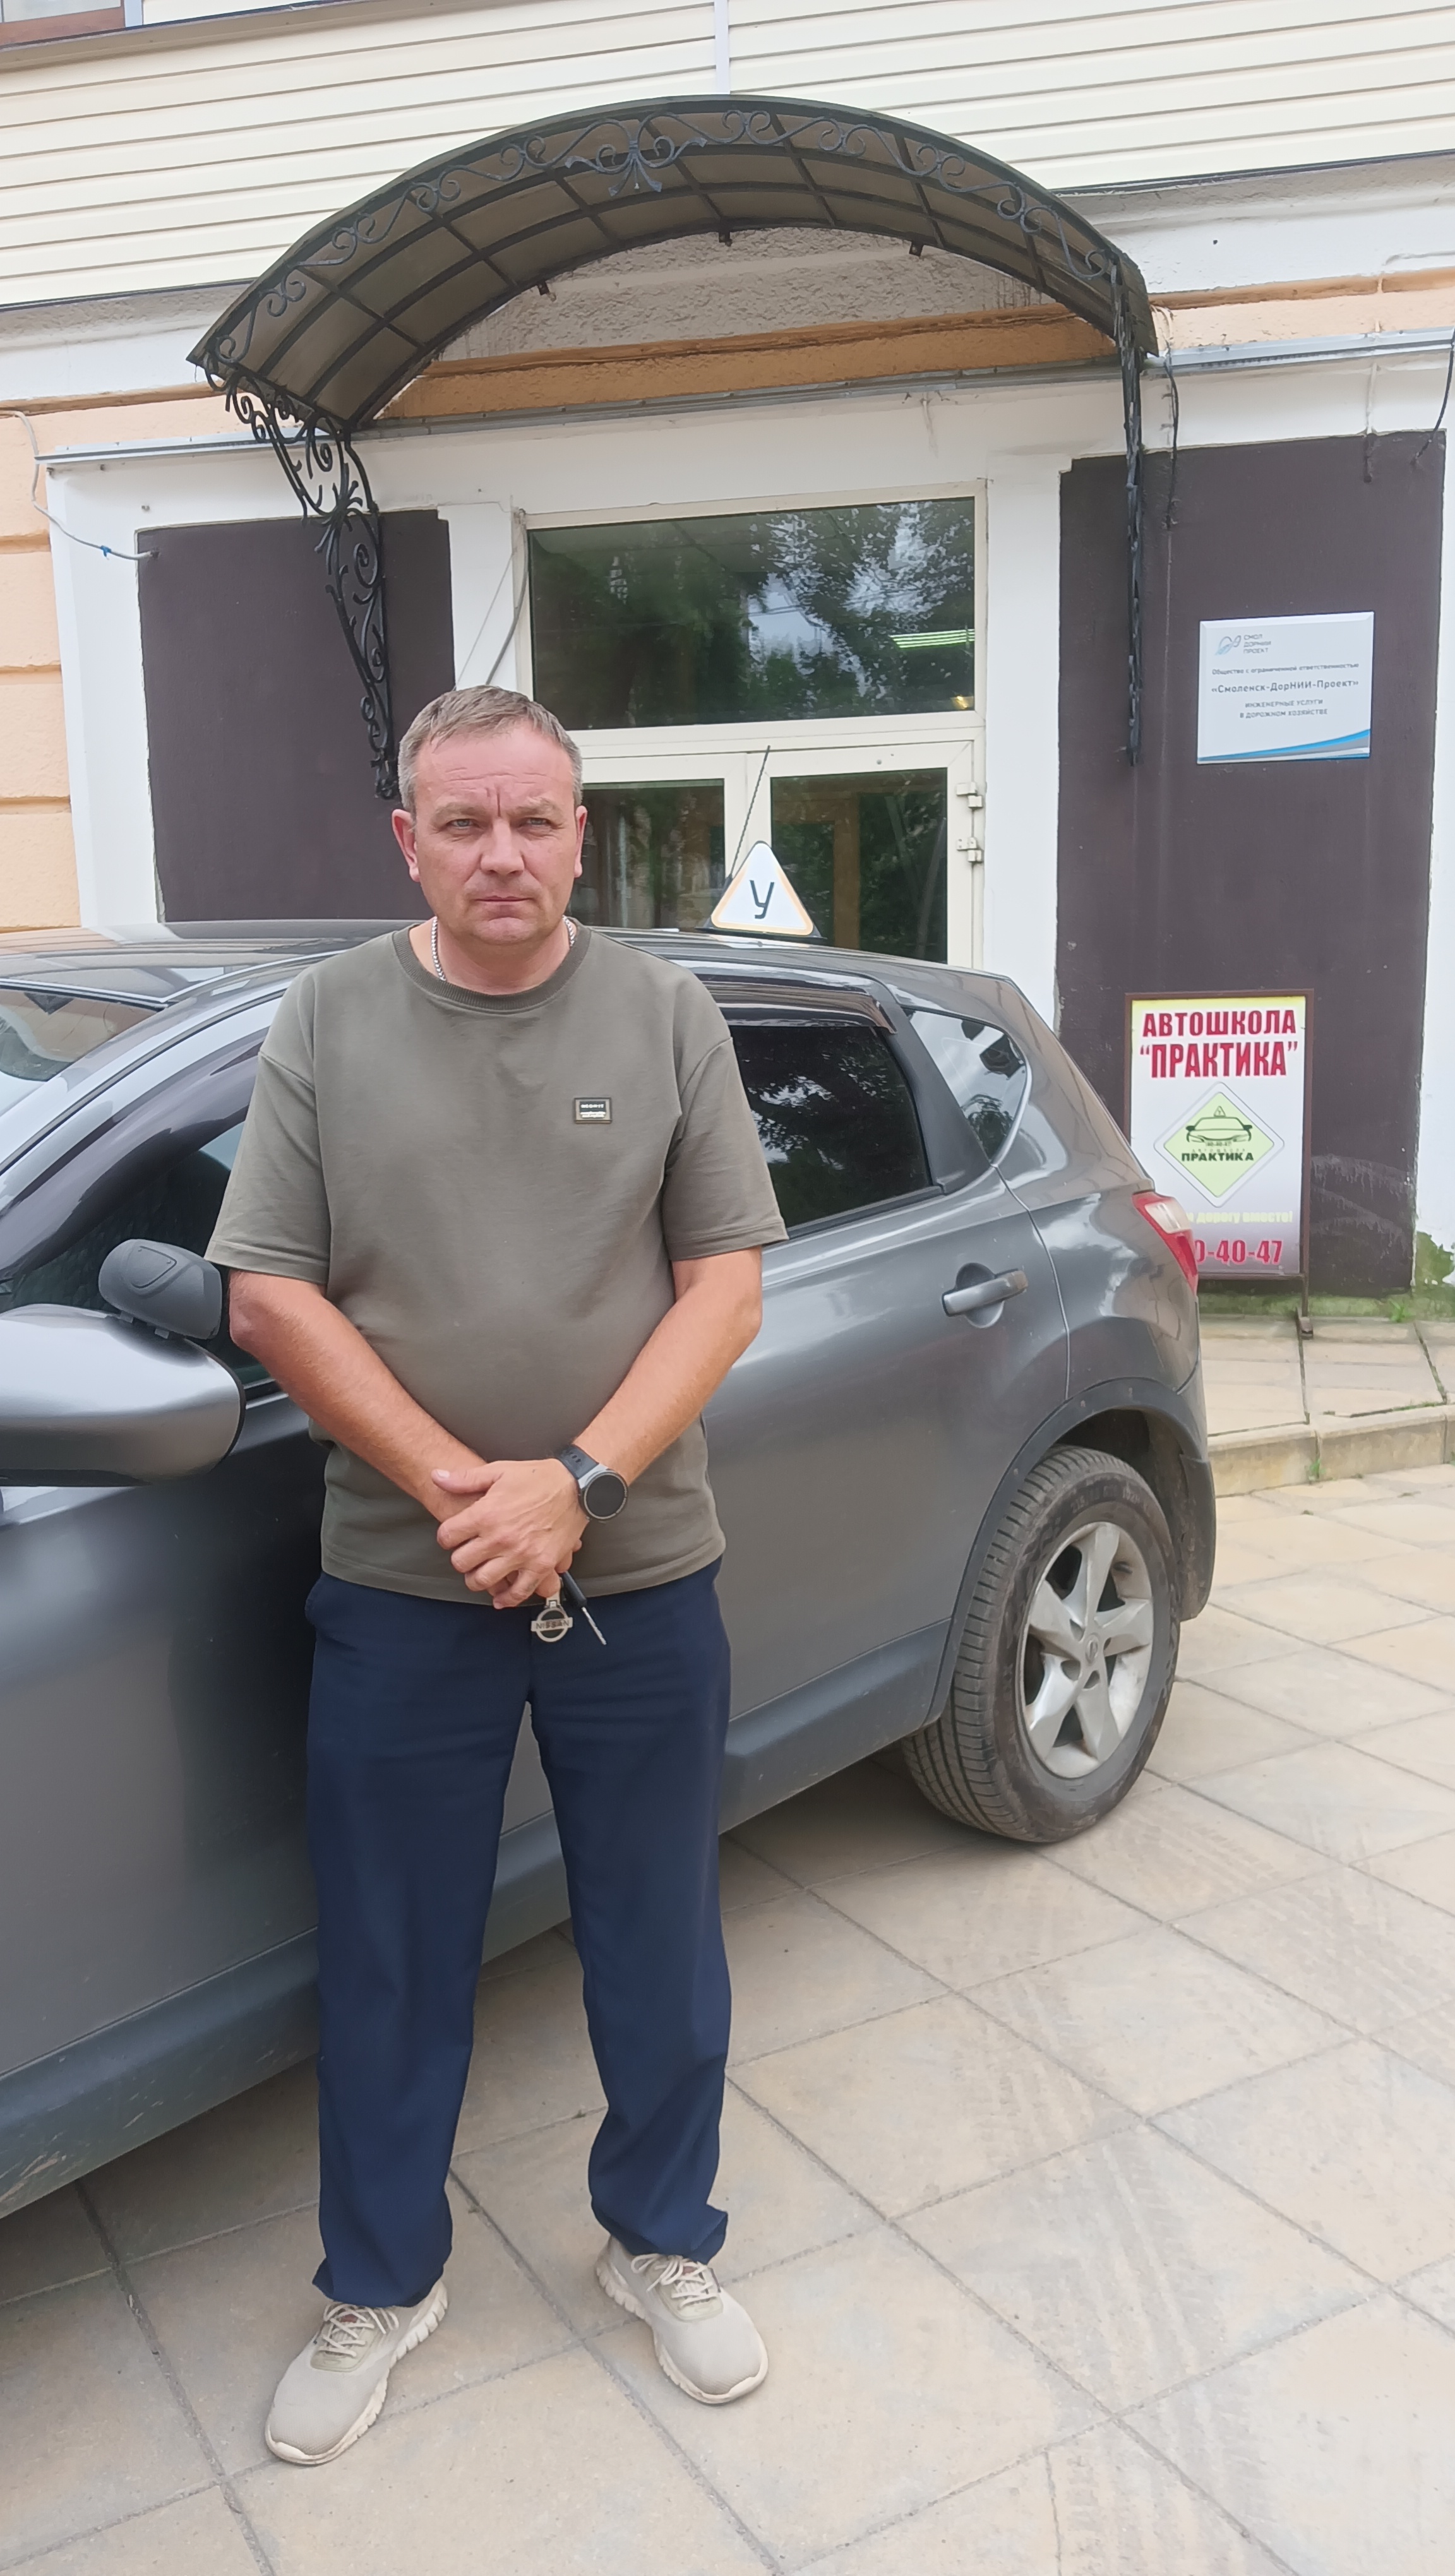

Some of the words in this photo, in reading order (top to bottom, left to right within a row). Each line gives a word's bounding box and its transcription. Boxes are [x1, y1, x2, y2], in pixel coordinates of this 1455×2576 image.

[1251, 665, 1297, 674] ограниченной
[1211, 680, 1359, 693] «Смоленск-ДорНИИ-Проект»
[750, 880, 775, 919] У
[1142, 1010, 1296, 1037] АВТОШКОЛА
[1182, 1152, 1254, 1162] ПРАКТИКА
[1194, 1239, 1282, 1263] 0-40-47
[536, 1619, 570, 1630] NISSAN
